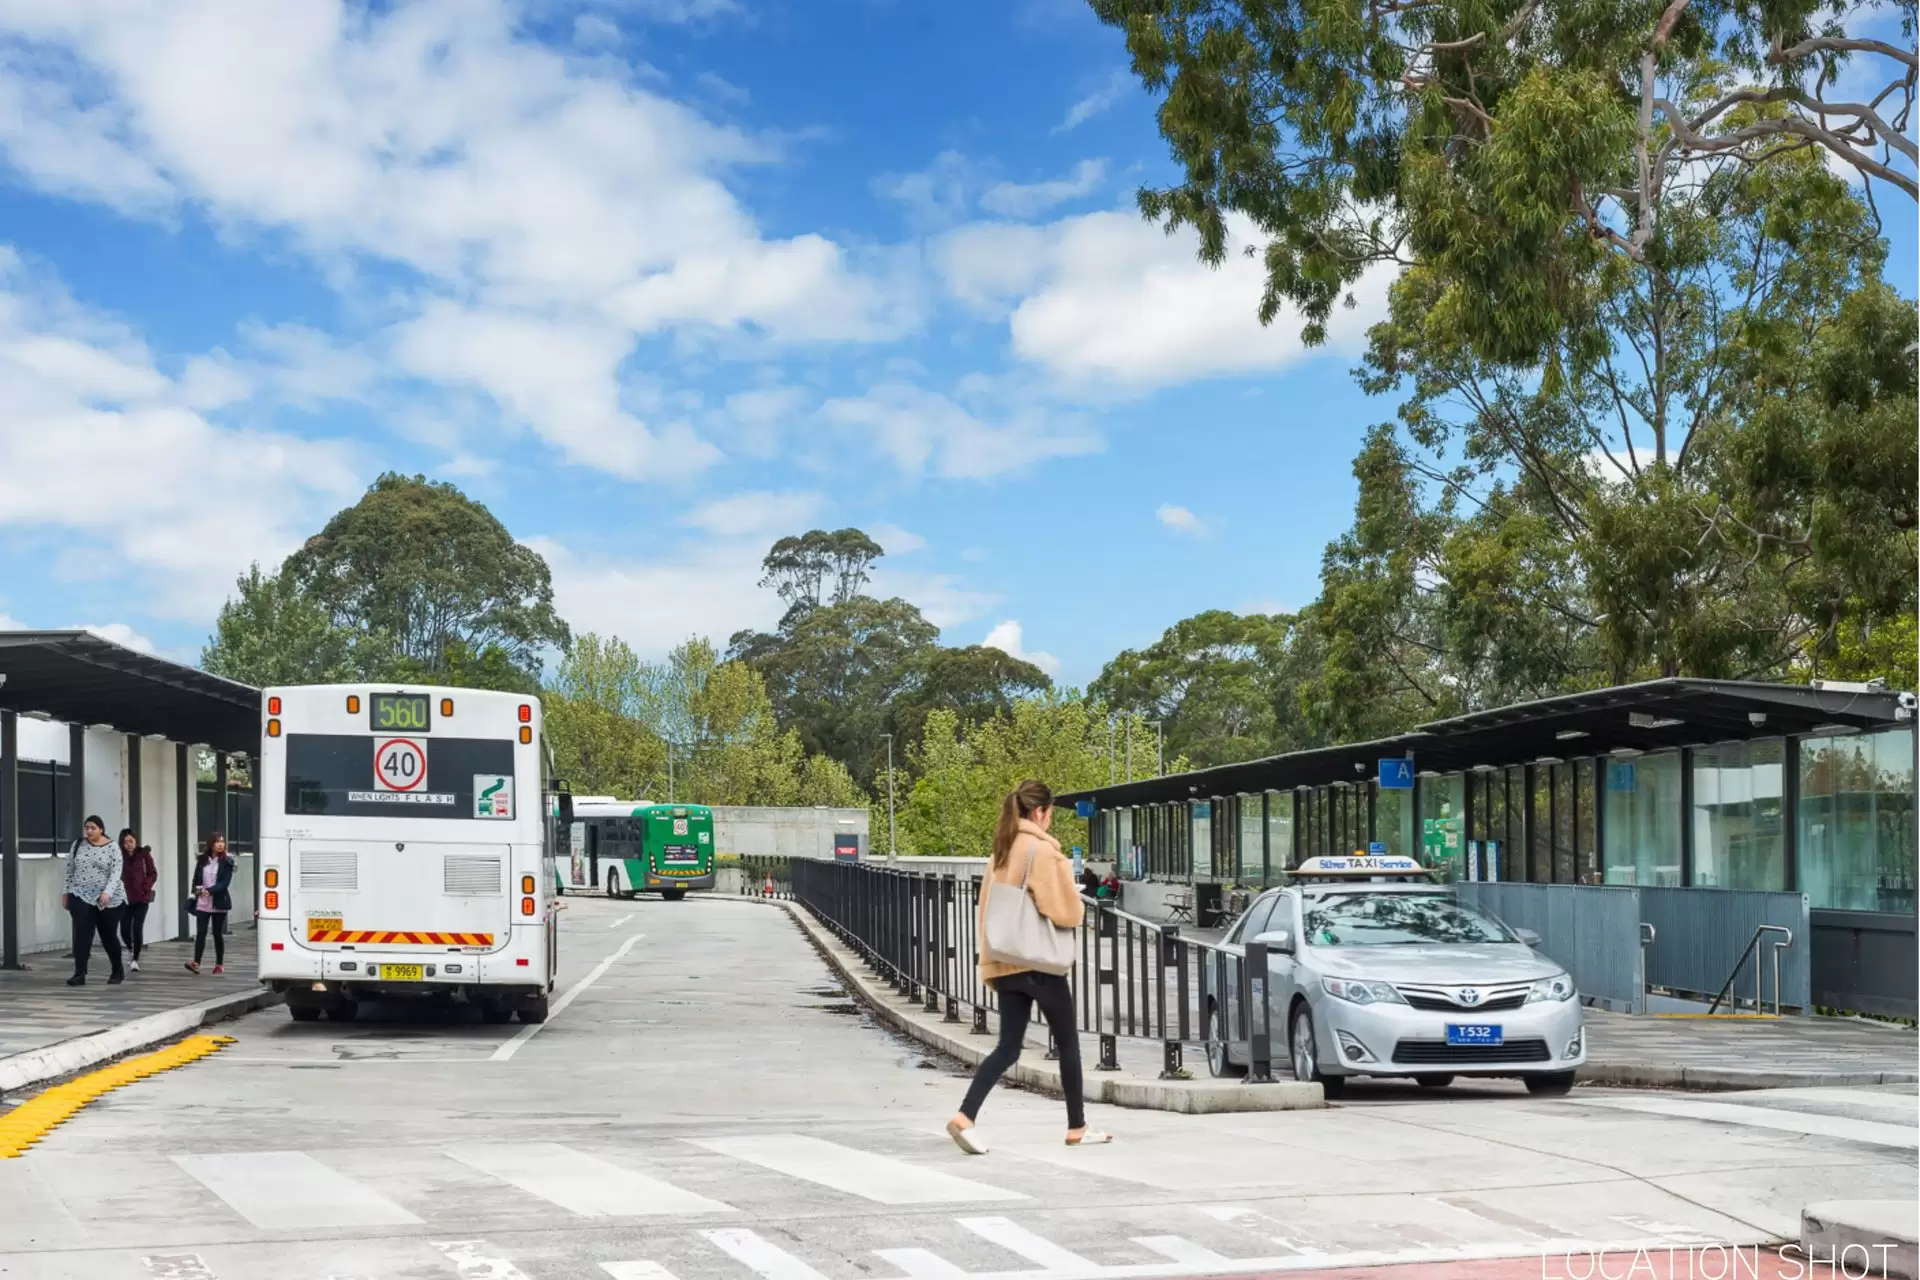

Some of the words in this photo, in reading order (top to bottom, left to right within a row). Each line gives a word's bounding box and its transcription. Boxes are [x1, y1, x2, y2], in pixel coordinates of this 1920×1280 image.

[380, 697, 426, 728] 560
[384, 751, 415, 777] 40
[1397, 762, 1410, 780] A
[350, 793, 372, 801] WHEN
[374, 793, 400, 801] LIGHTS
[1347, 858, 1377, 868] TAXI
[1380, 860, 1412, 869] Service
[395, 966, 417, 977] 9969
